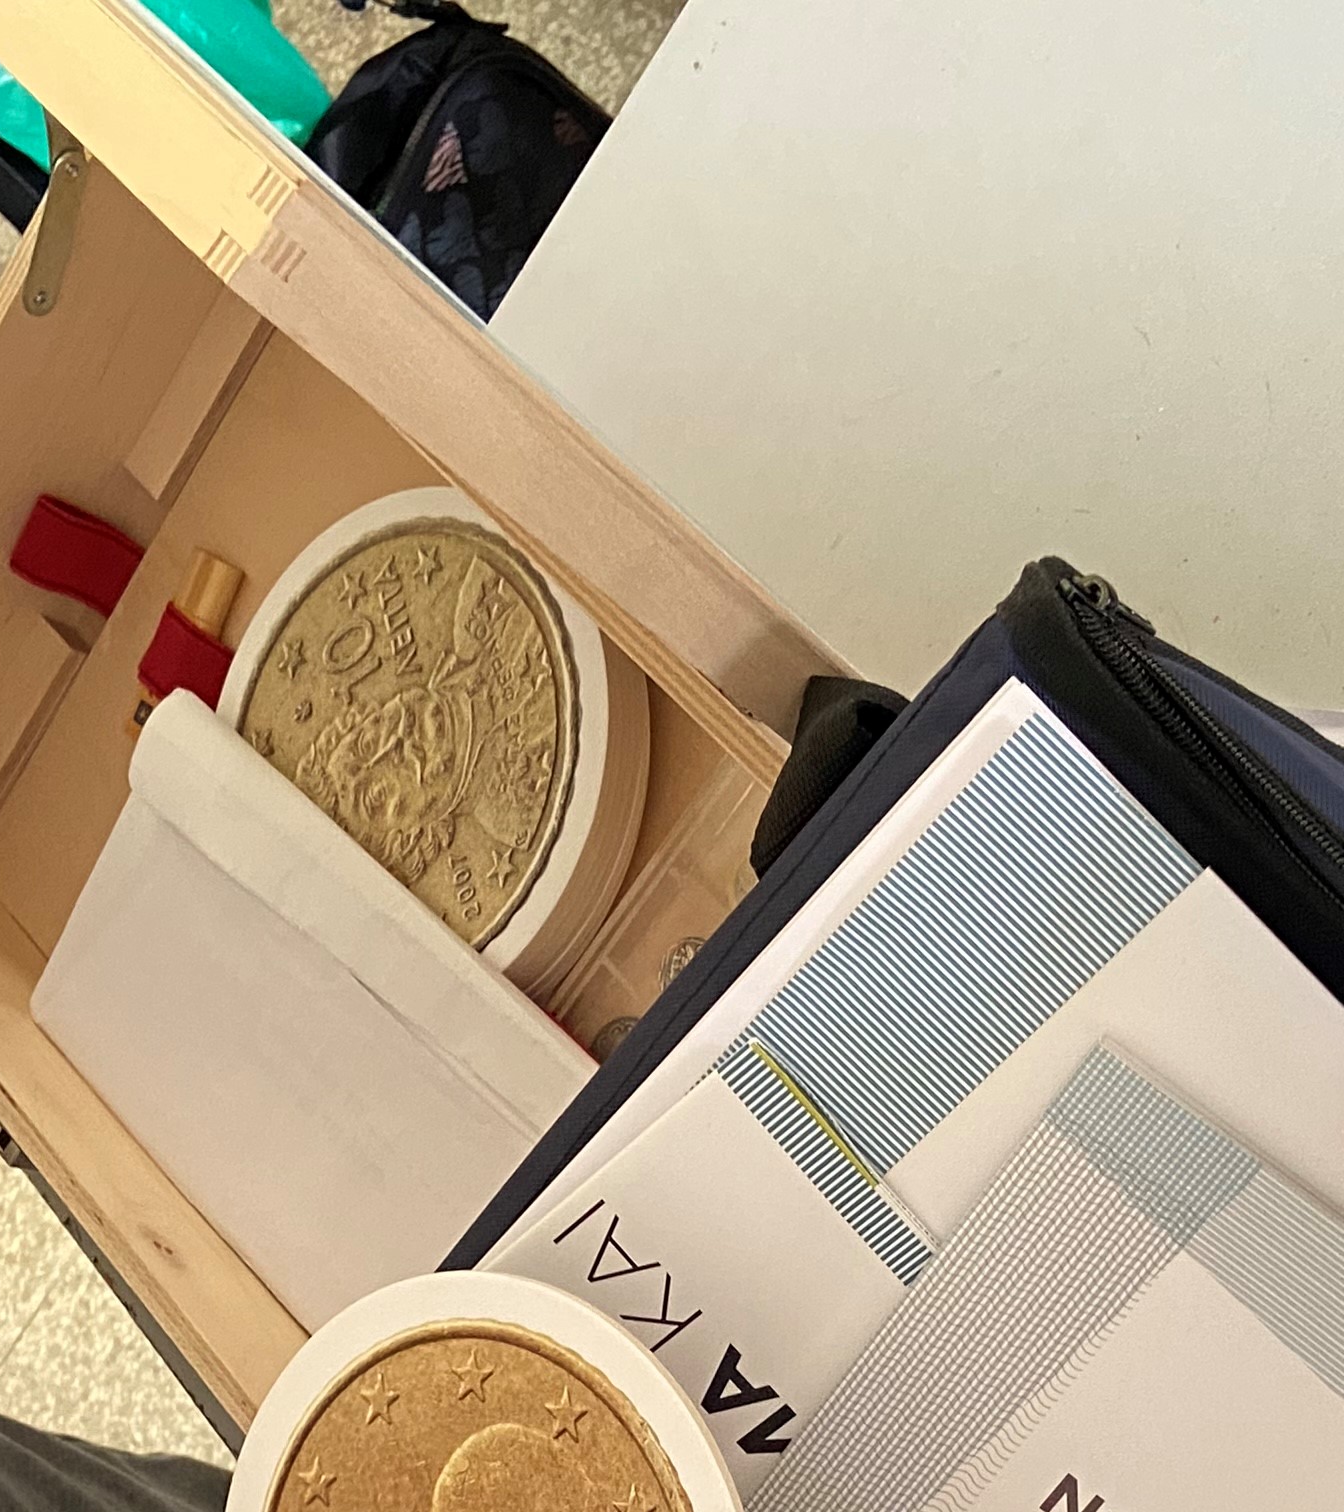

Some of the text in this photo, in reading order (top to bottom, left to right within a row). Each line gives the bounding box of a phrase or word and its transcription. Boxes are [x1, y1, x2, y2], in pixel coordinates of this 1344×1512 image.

[320, 615, 384, 704] 10
[447, 854, 482, 922] 2007
[553, 1199, 703, 1353] ΚΑΙ
